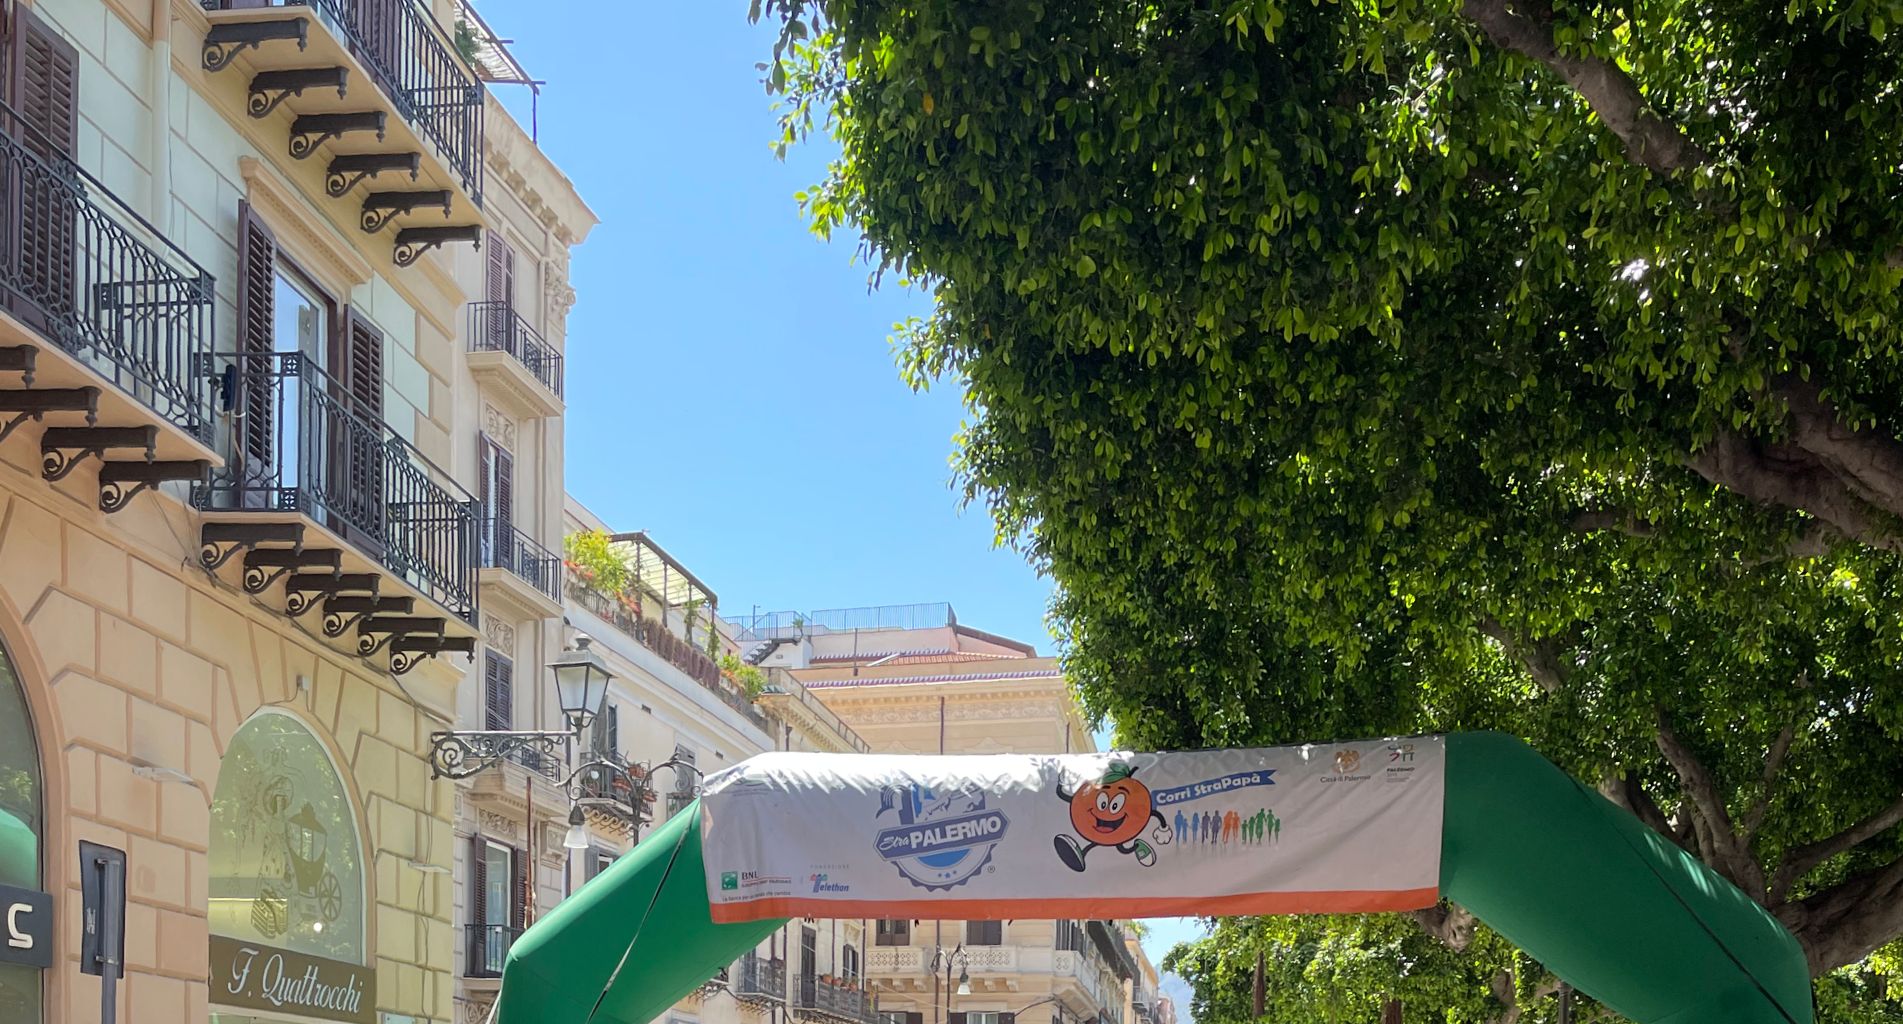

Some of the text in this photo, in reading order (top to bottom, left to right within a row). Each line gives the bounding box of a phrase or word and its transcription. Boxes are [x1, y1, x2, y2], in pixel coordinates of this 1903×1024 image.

[1156, 773, 1261, 804] Corri StraPapà
[909, 815, 1002, 849] PALERMO
[741, 870, 759, 880] BNL
[261, 953, 364, 1014] Quattrocchi
